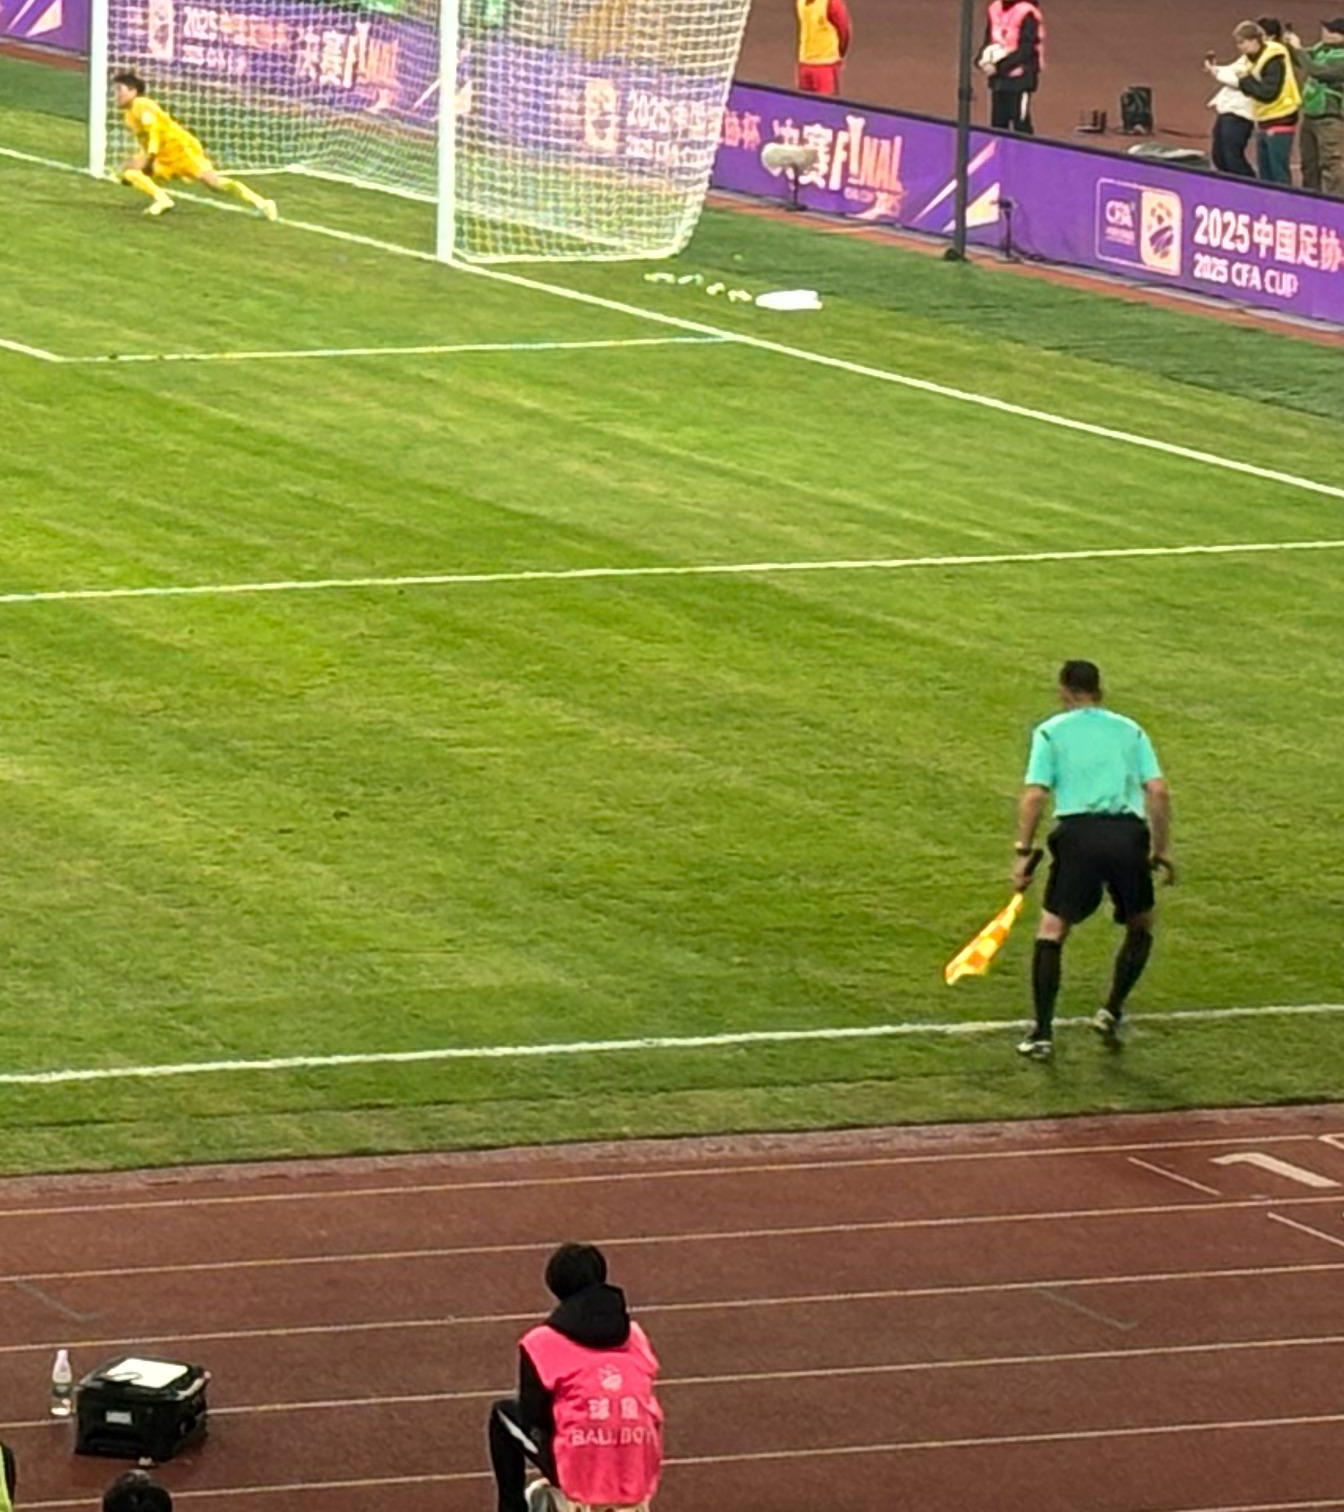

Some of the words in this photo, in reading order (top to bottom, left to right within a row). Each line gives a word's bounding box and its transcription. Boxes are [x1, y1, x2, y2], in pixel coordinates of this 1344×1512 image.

[1193, 254, 1229, 284] 2025
[1231, 261, 1262, 291] CFA
[1264, 269, 1299, 298] CUP
